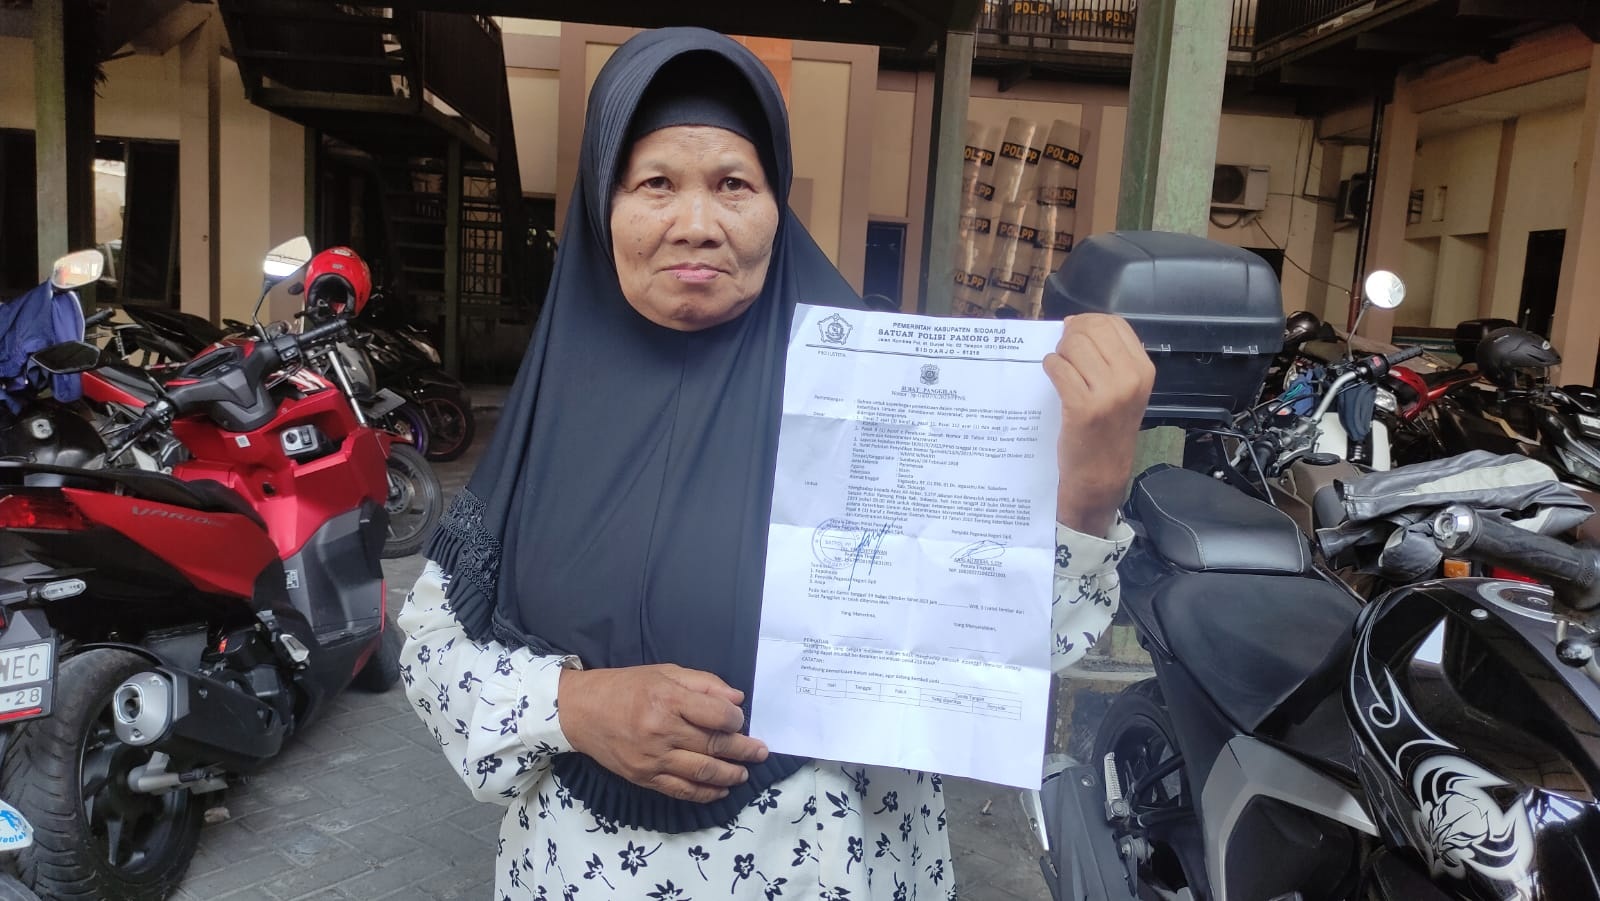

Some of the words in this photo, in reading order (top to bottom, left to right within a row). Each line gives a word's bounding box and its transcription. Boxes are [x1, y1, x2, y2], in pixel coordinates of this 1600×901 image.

[1046, 145, 1081, 165] POL.PP
[893, 322, 931, 332] PEMERINTAH
[878, 329, 914, 338] SATUAN
[918, 332, 946, 341] POLISI
[950, 335, 989, 343] PAMONG
[994, 336, 1024, 344] PRAJA
[915, 347, 955, 355] SIDOARJO
[923, 387, 957, 395] PANGGILAN
[131, 505, 209, 525] VARIO
